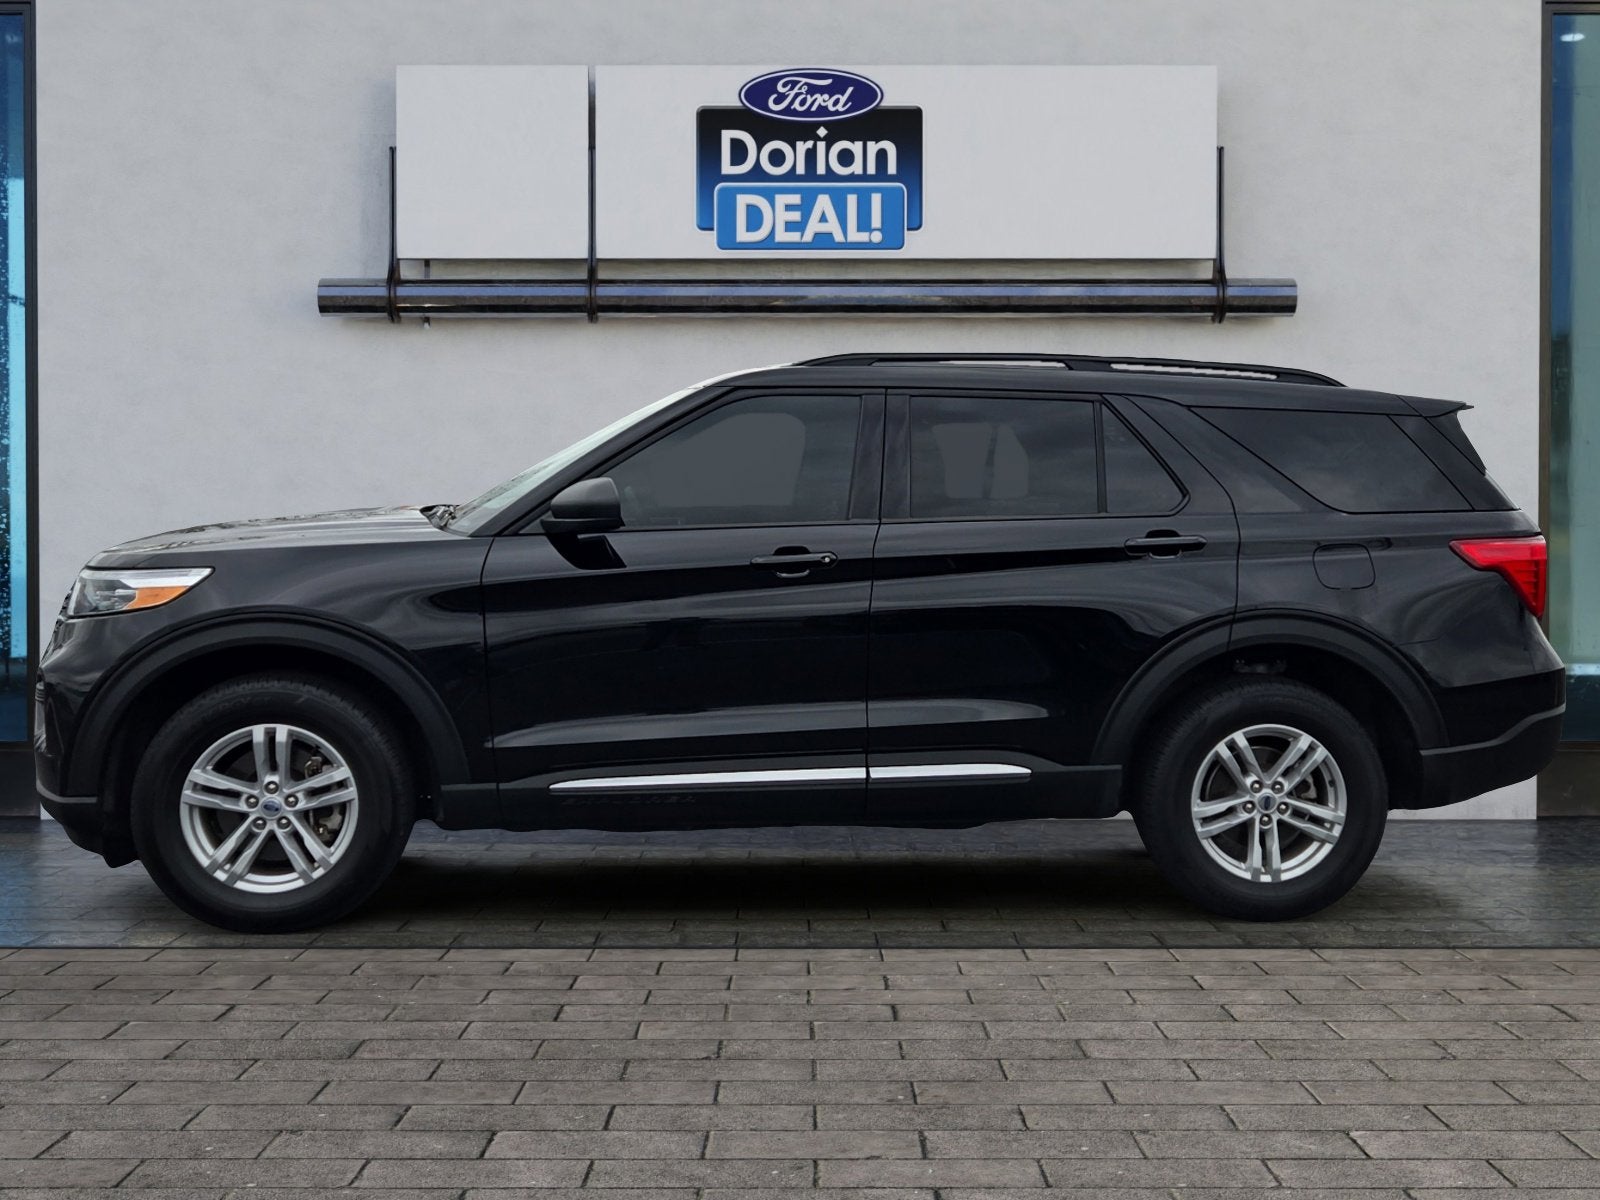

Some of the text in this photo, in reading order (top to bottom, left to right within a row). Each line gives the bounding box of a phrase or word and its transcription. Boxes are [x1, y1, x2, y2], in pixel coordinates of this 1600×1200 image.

[768, 76, 854, 112] Ford
[721, 126, 897, 176] Dorian
[736, 193, 883, 244] DEAL!
